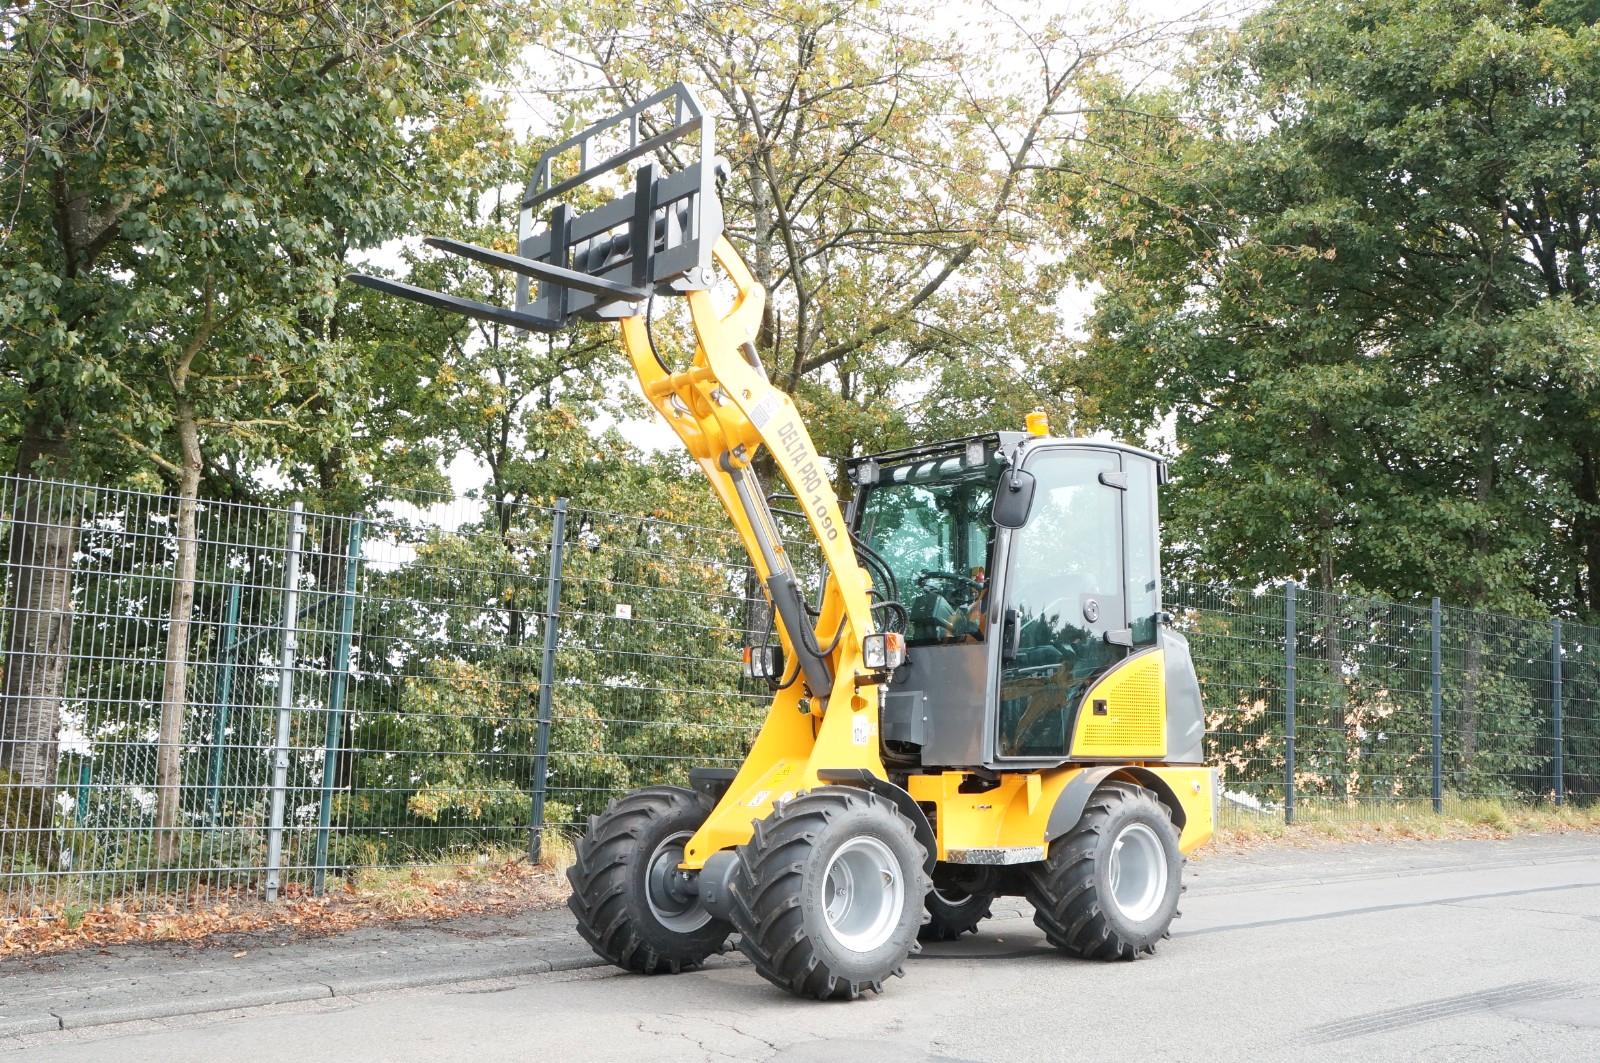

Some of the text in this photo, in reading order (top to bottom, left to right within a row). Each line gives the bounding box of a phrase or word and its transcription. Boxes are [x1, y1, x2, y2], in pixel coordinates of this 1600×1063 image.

[777, 421, 838, 541] DELTA PRO 1090
